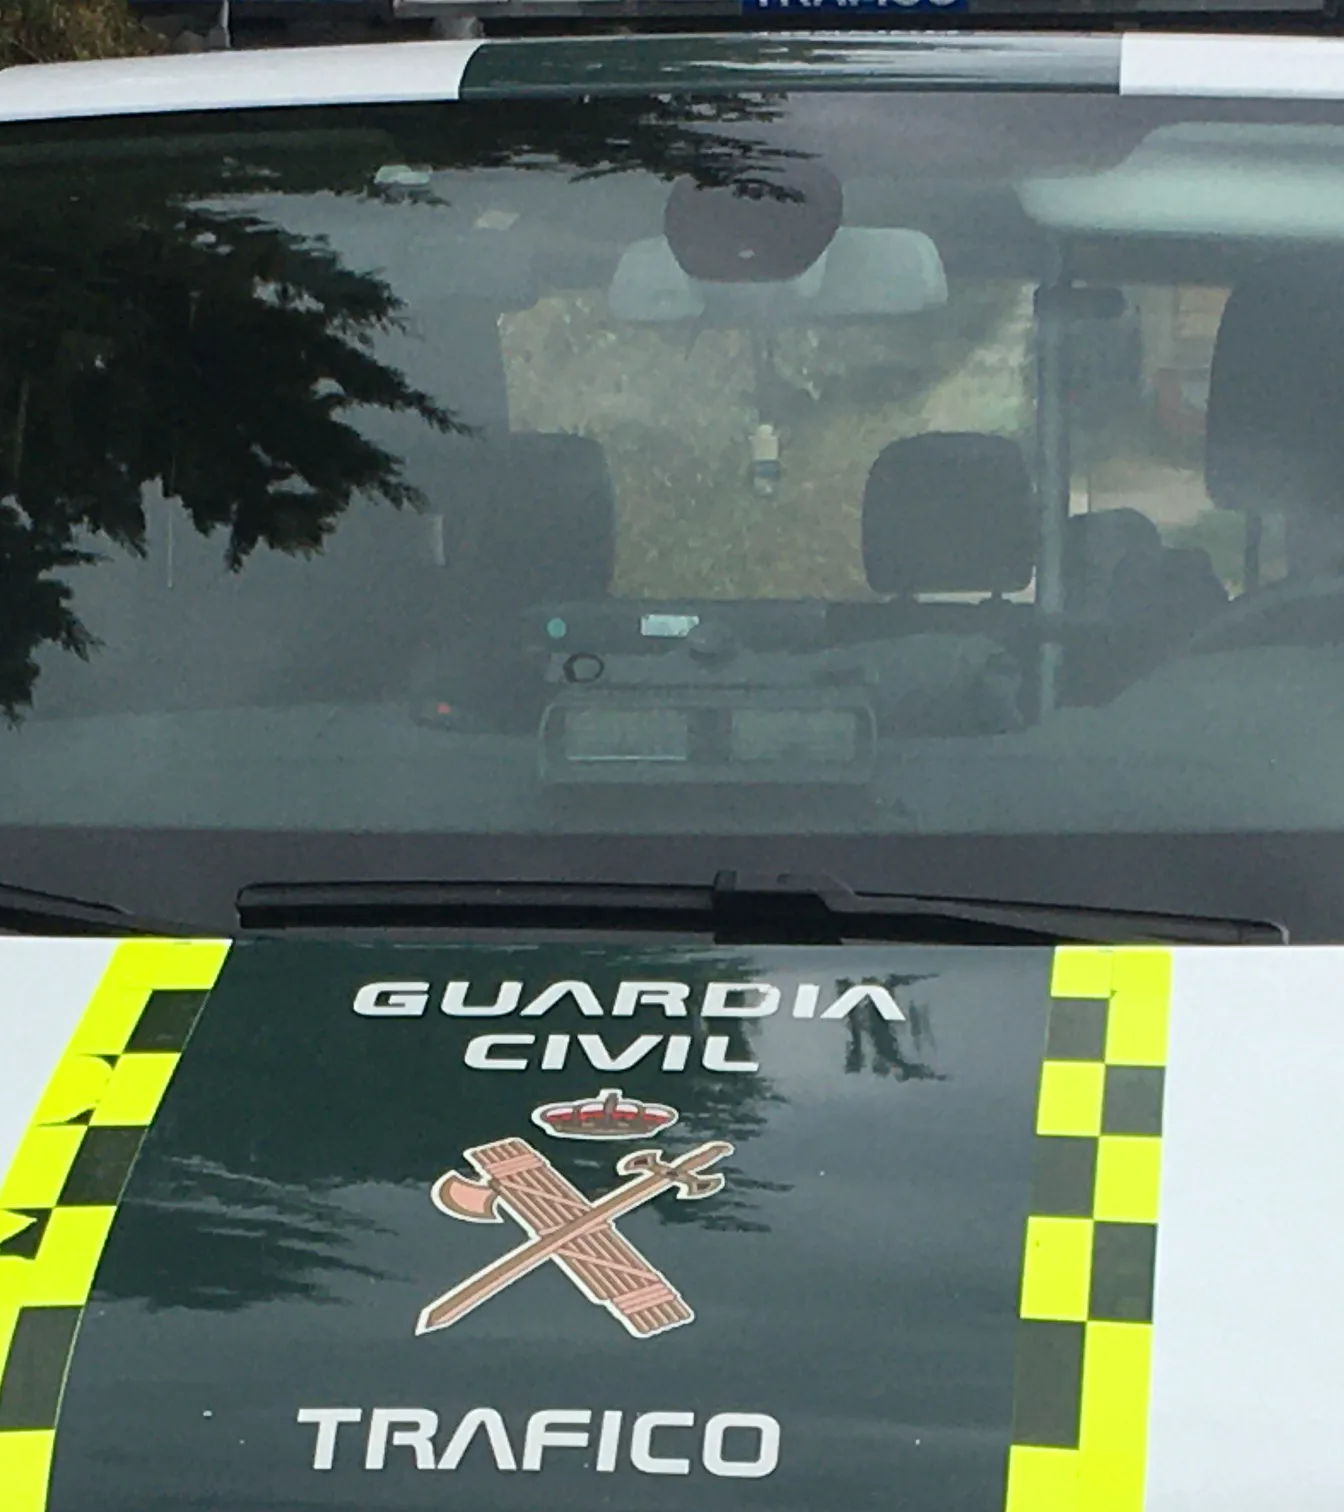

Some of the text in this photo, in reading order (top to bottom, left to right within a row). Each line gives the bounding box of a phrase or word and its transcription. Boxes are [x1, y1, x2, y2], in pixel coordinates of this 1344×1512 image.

[352, 980, 907, 1021] GUARDIA
[463, 1033, 760, 1073] CIVIL
[296, 1407, 782, 1478] TRAFICO
